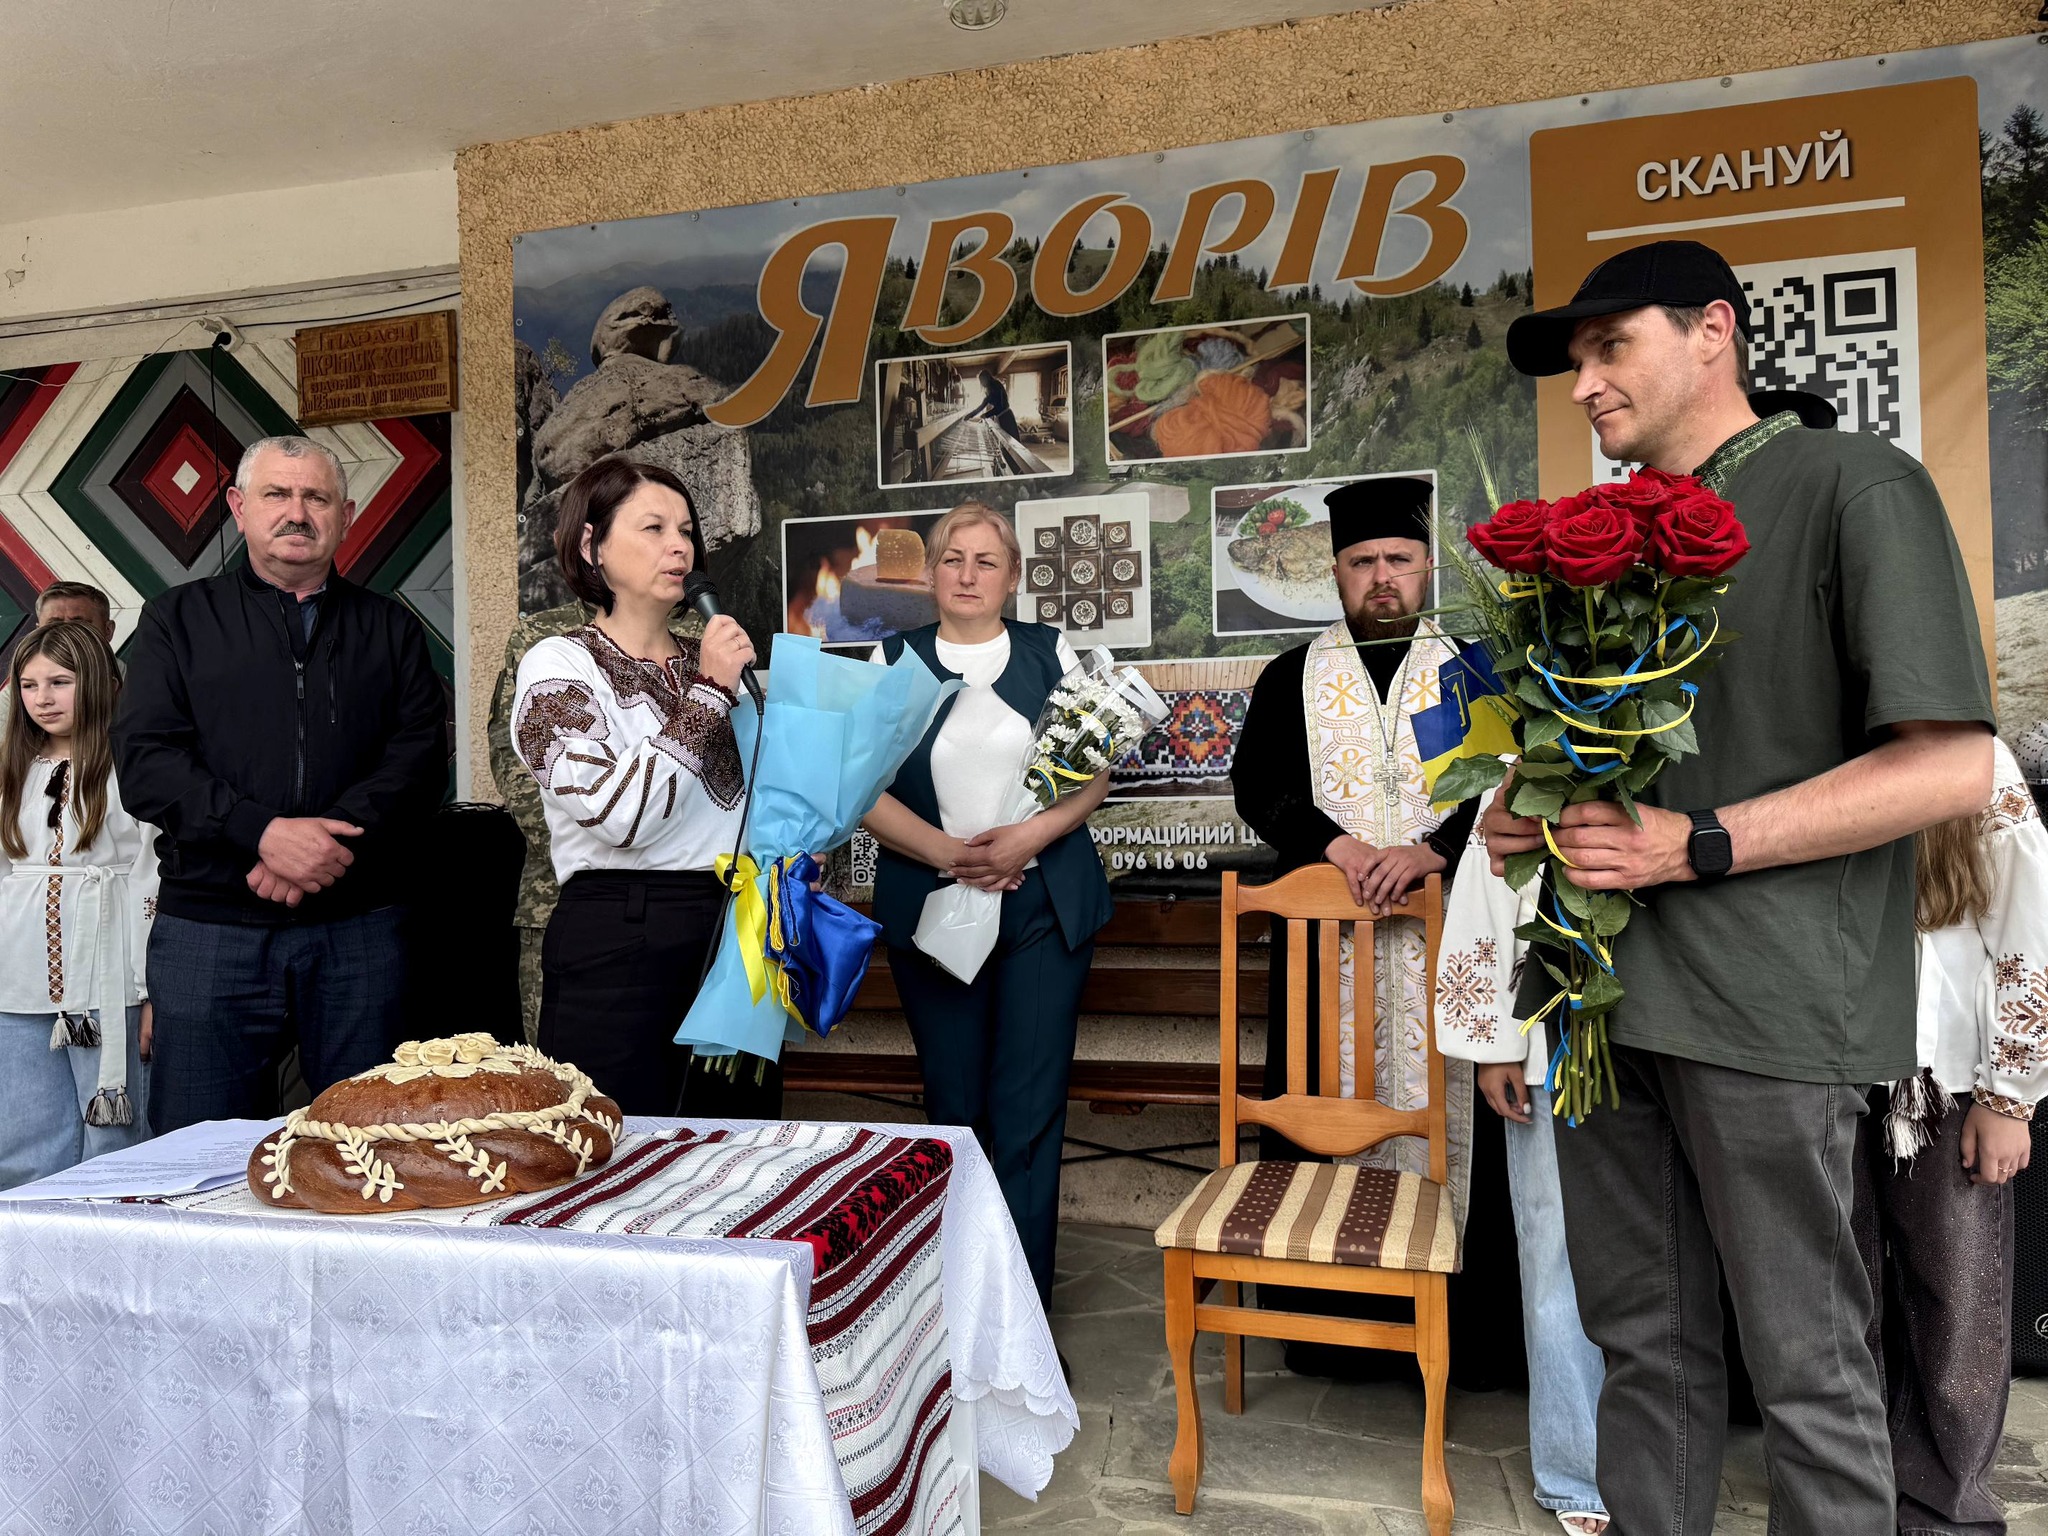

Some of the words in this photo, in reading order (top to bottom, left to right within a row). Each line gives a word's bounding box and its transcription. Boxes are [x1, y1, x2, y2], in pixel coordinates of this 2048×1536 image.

[1636, 128, 1851, 201] СКАНУЙ
[704, 155, 1468, 428] ЯВОРІВ
[1089, 821, 1235, 847] ФОРМАЦІЙНИЙ
[1111, 851, 1147, 870] 096
[1154, 851, 1175, 870] 16
[1183, 851, 1208, 870] 06
